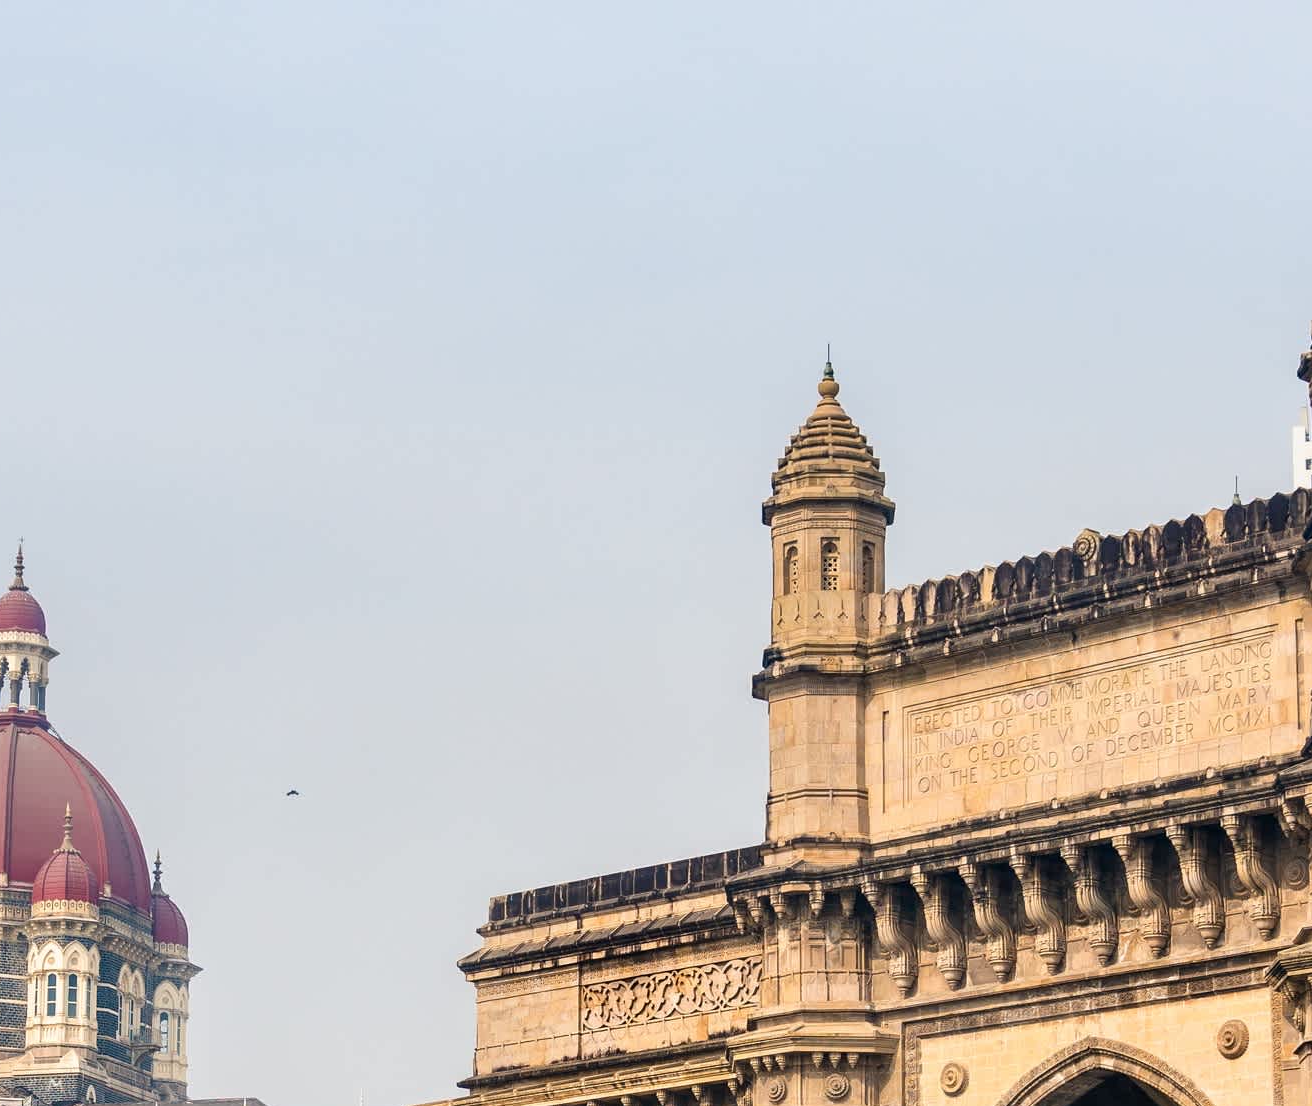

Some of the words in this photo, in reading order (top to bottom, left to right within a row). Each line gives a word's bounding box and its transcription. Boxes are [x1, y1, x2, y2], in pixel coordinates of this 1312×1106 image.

[914, 705, 982, 734] ERECTED
[991, 698, 1013, 717] TO
[1023, 667, 1151, 710] COMMEMORATE
[1159, 659, 1188, 681] THE
[1200, 641, 1272, 673] LANDING
[914, 736, 929, 754] IN
[939, 727, 979, 746] INDIA
[992, 718, 1013, 738] OF
[1030, 706, 1073, 730] THEIR
[1087, 688, 1160, 719] IMPERIAL
[1176, 663, 1271, 700] MAJESTIES
[915, 752, 953, 774] KING
[968, 734, 1040, 763] GEORGE
[1086, 717, 1120, 739] AND
[1138, 701, 1201, 728] QUEEN
[1217, 686, 1271, 712] MARY
[918, 774, 942, 793] ON
[950, 767, 978, 786] THE
[991, 751, 1058, 780] SECOND
[1072, 743, 1094, 762] OF
[1105, 723, 1194, 757] DECEMBER
[1208, 706, 1271, 736] MCMXI
